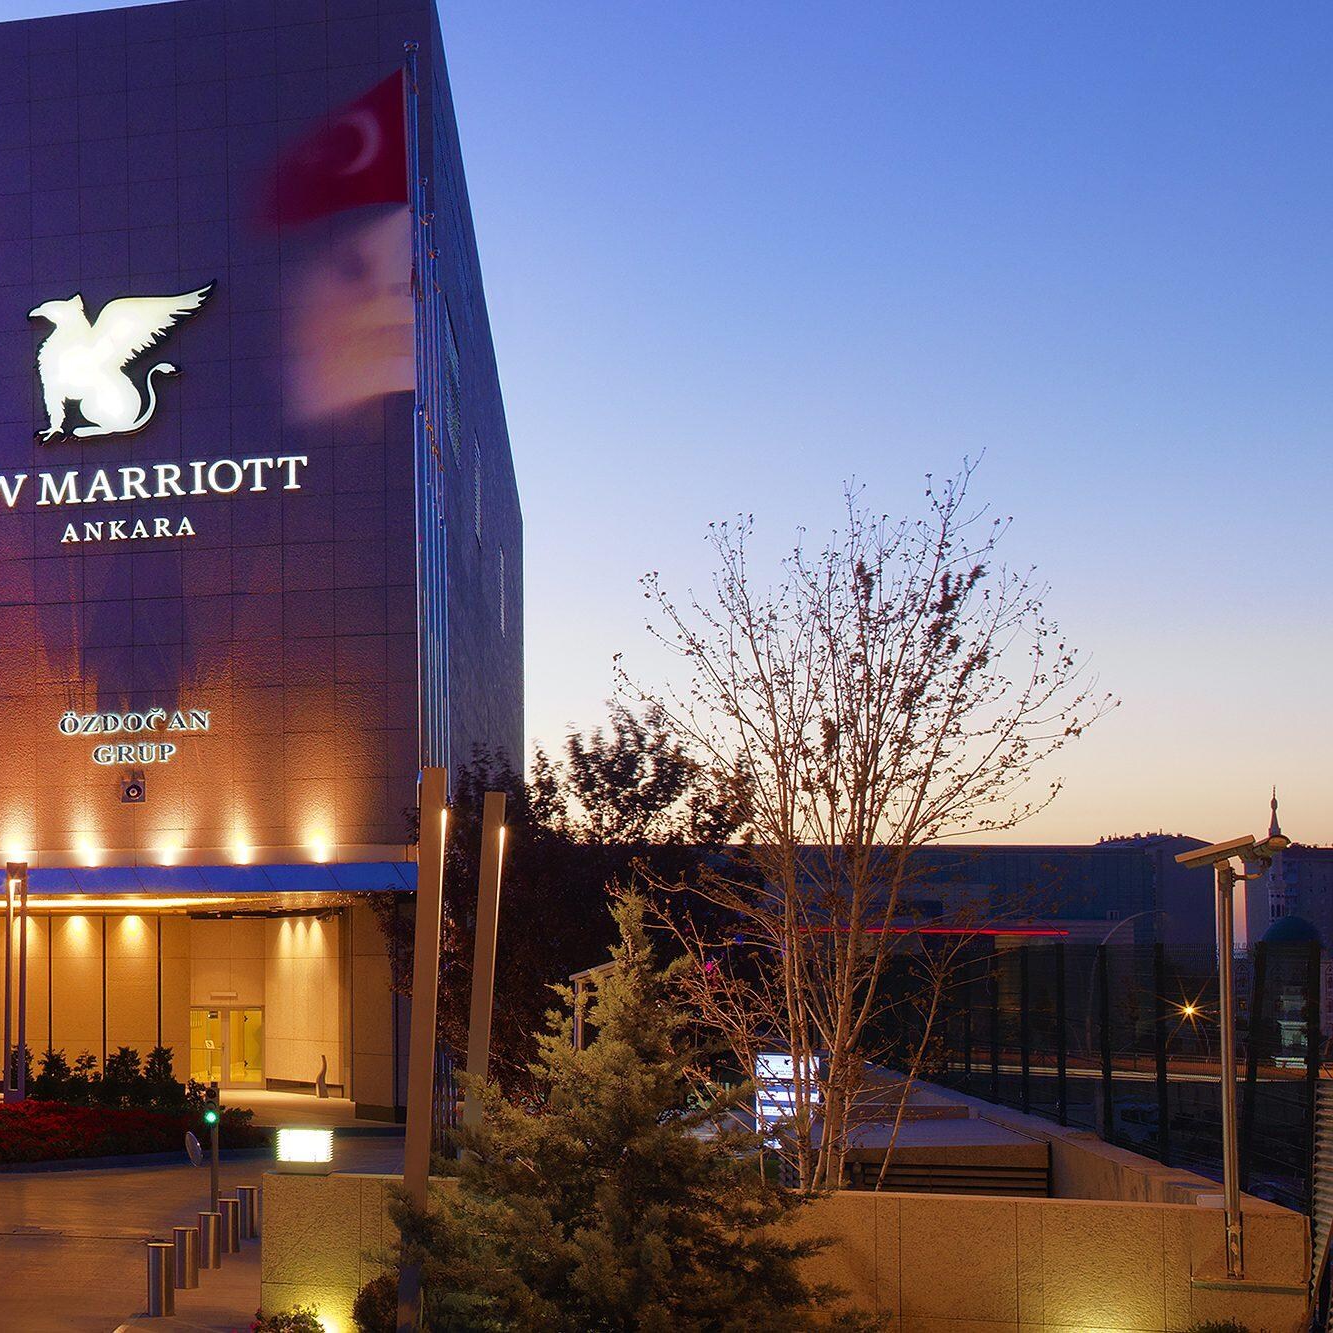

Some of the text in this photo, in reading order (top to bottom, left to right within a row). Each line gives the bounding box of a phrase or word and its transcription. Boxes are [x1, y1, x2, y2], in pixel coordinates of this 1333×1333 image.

[36, 455, 308, 506] MARRIOTT
[60, 516, 196, 543] ANKARA
[92, 743, 176, 766] GRUP
